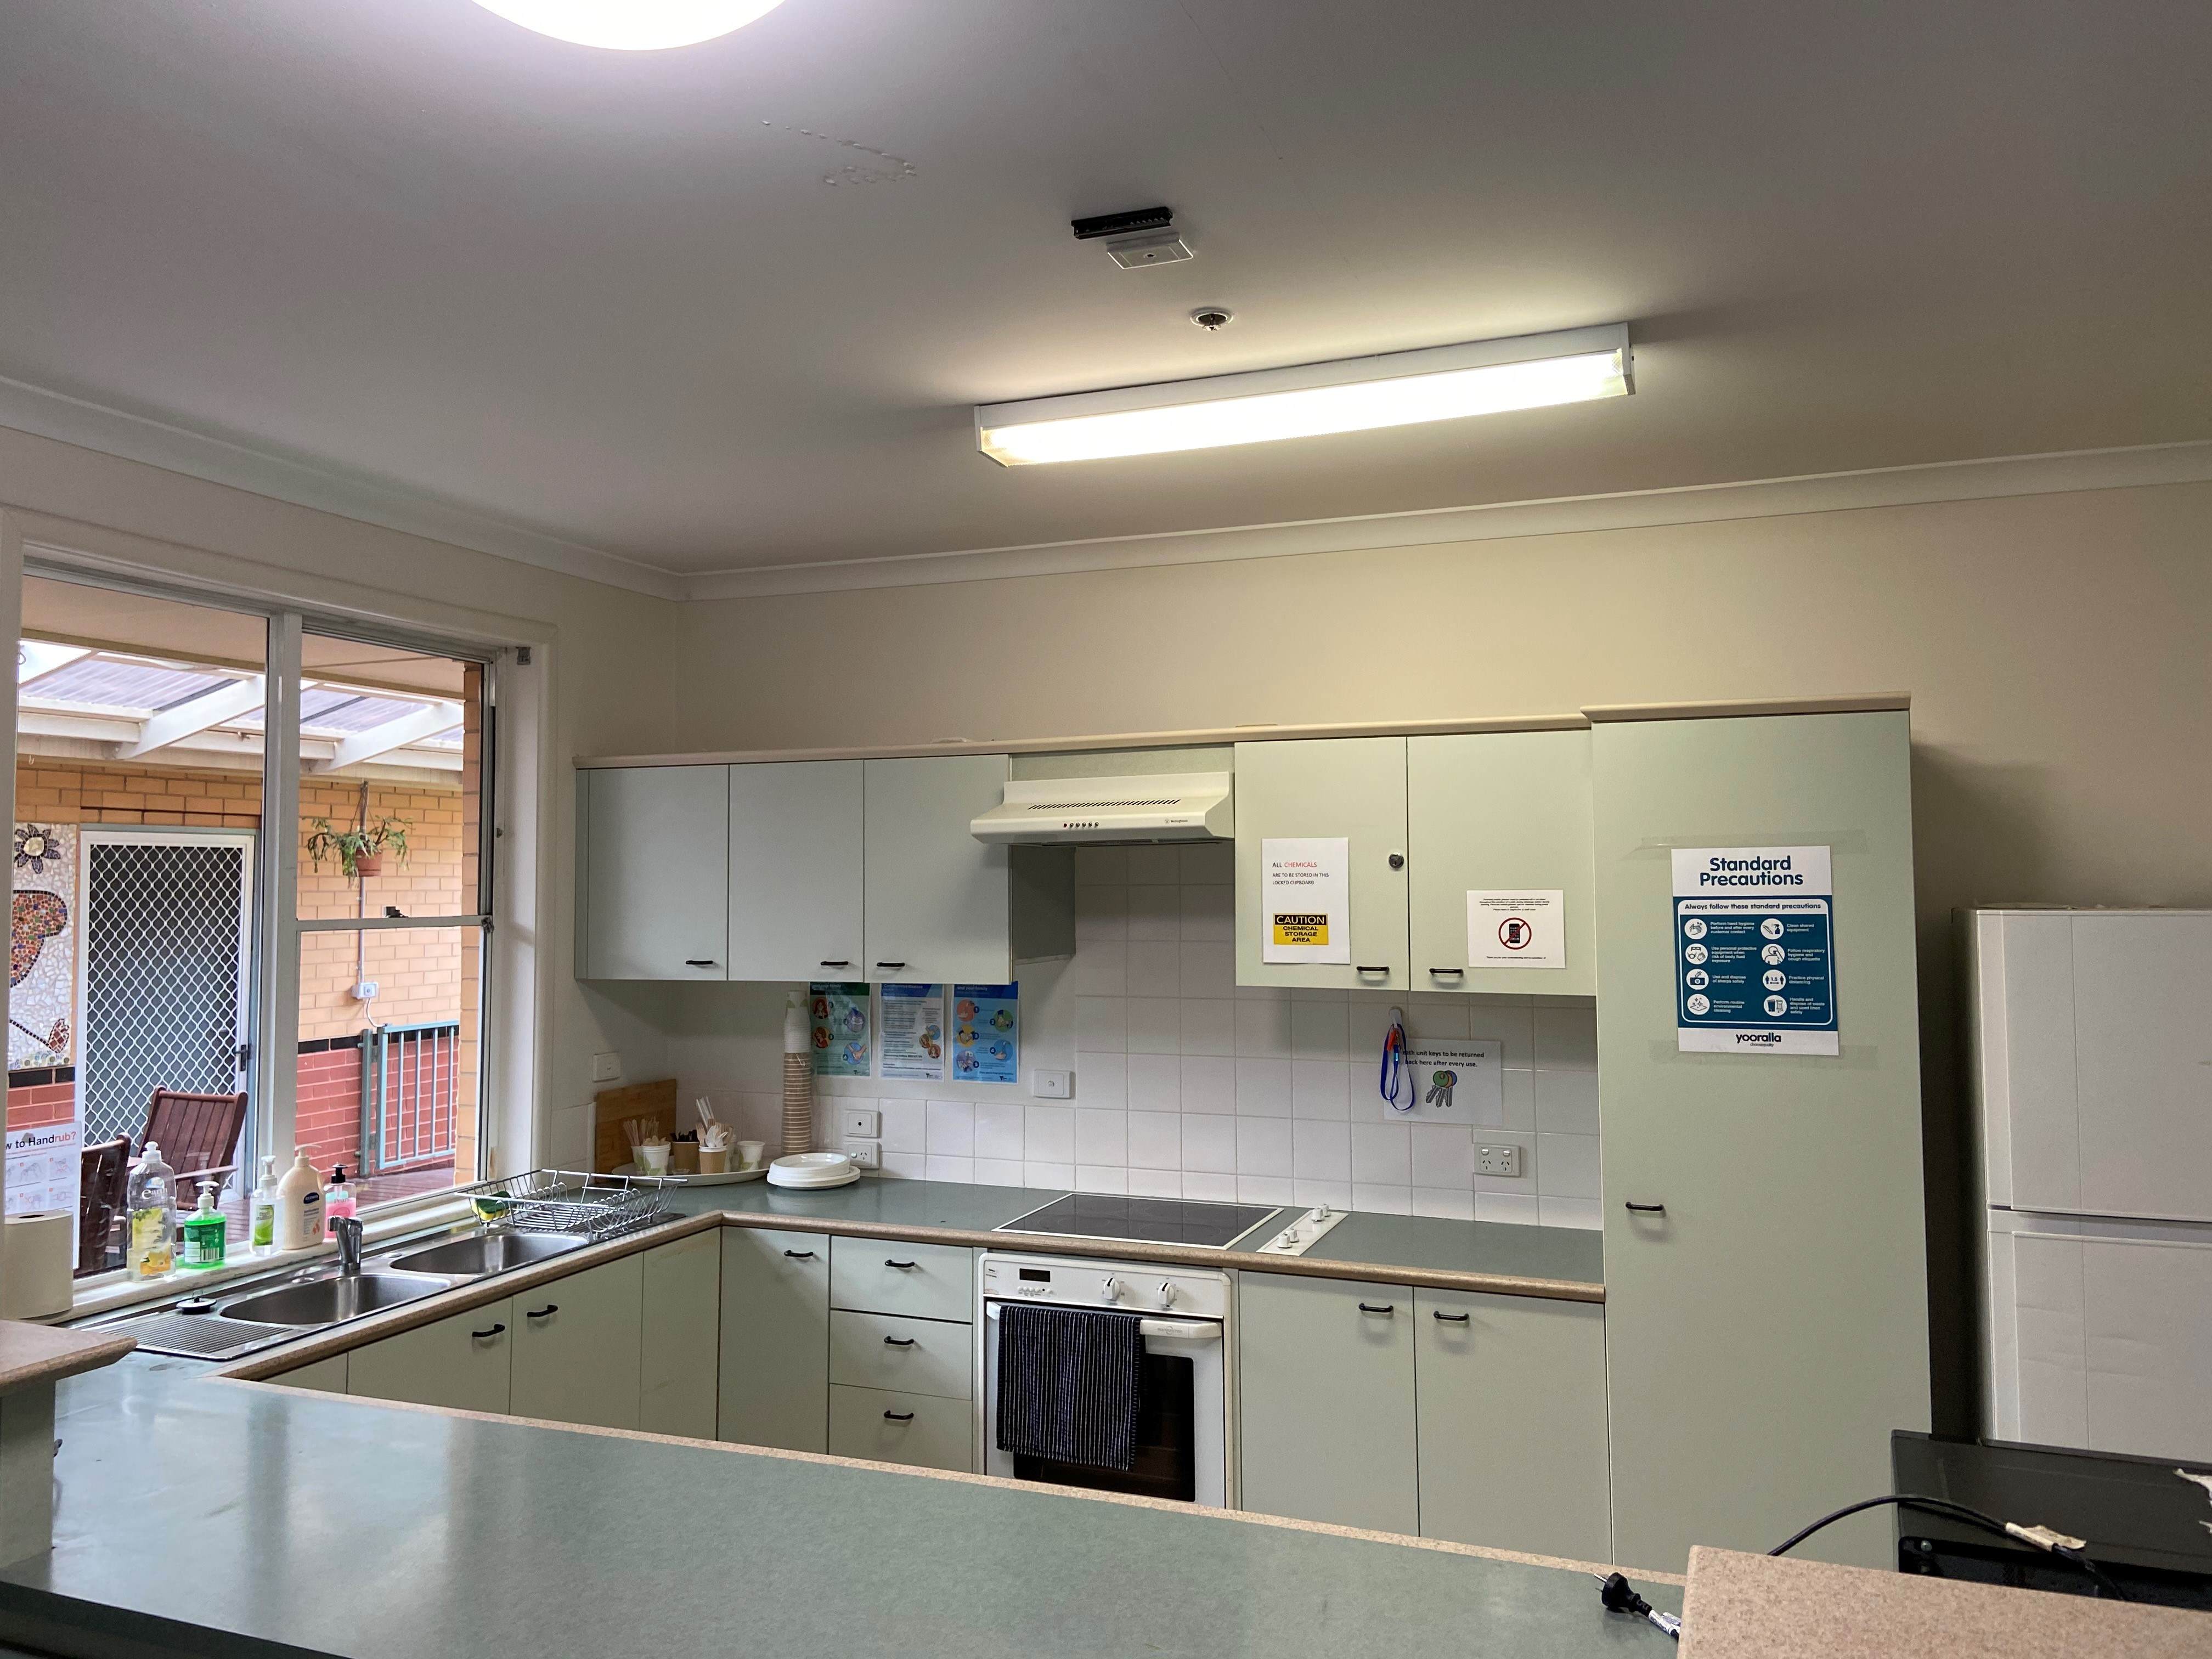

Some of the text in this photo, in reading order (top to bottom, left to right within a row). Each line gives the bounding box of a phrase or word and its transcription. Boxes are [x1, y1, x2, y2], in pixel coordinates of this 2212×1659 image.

[1710, 855, 1791, 871] Standard
[1700, 871, 1803, 886] Precautions
[1277, 916, 1324, 924] CAUTION
[1736, 1032, 1781, 1044] yooralla
[15, 1140, 25, 1148] to
[29, 1131, 77, 1147] Handrub?
